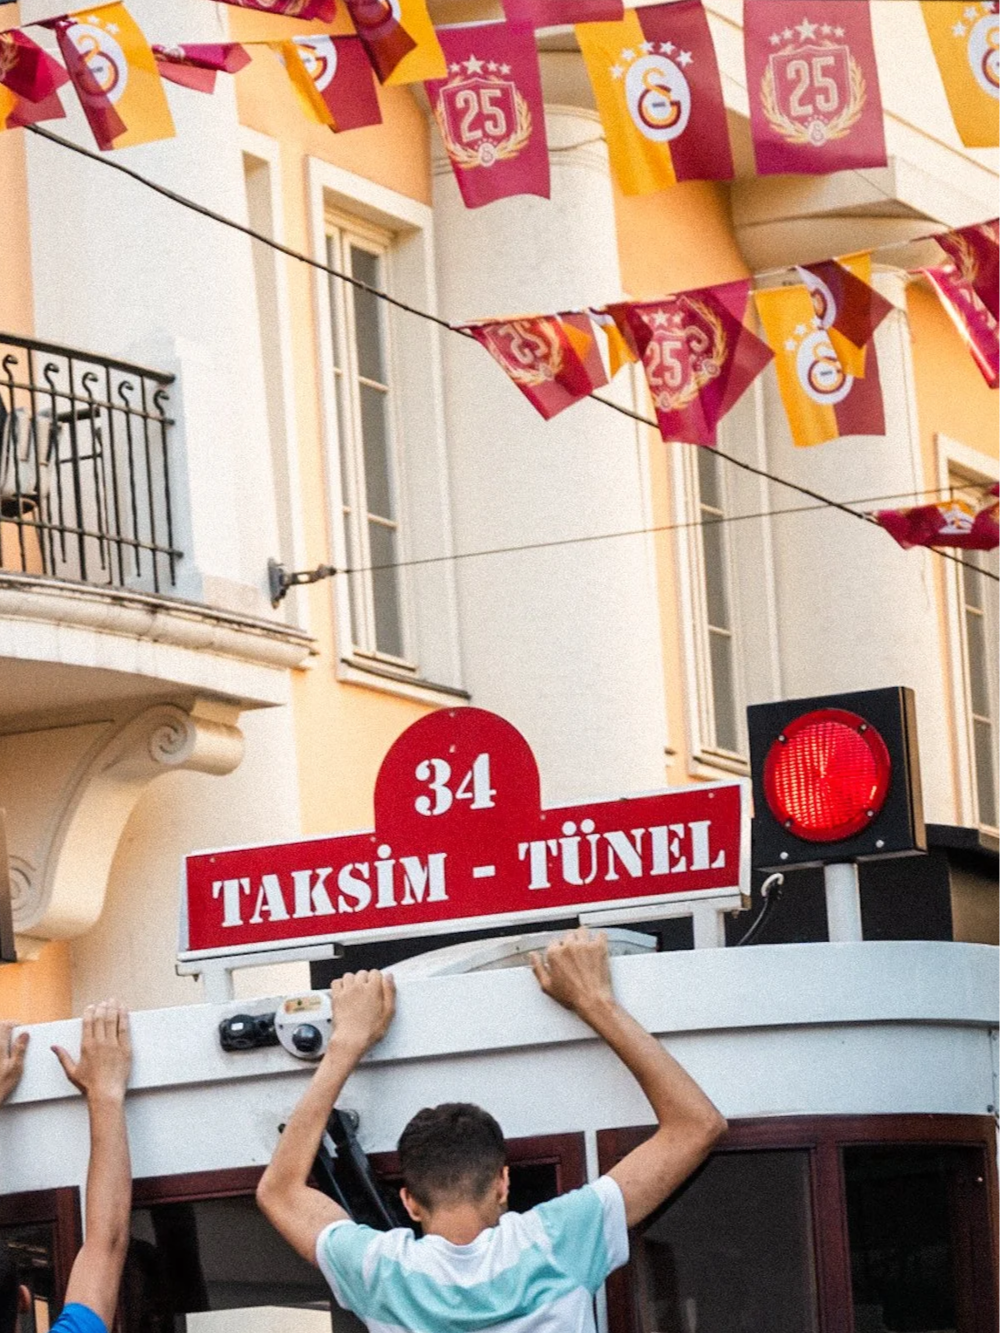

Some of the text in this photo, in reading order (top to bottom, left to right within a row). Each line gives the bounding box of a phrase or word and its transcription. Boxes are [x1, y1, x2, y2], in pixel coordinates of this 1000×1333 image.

[455, 88, 507, 143] 25
[784, 56, 840, 118] 25
[645, 340, 683, 387] 25
[414, 752, 497, 816] 34
[211, 818, 726, 928] TAKSİM - TÜNEL
